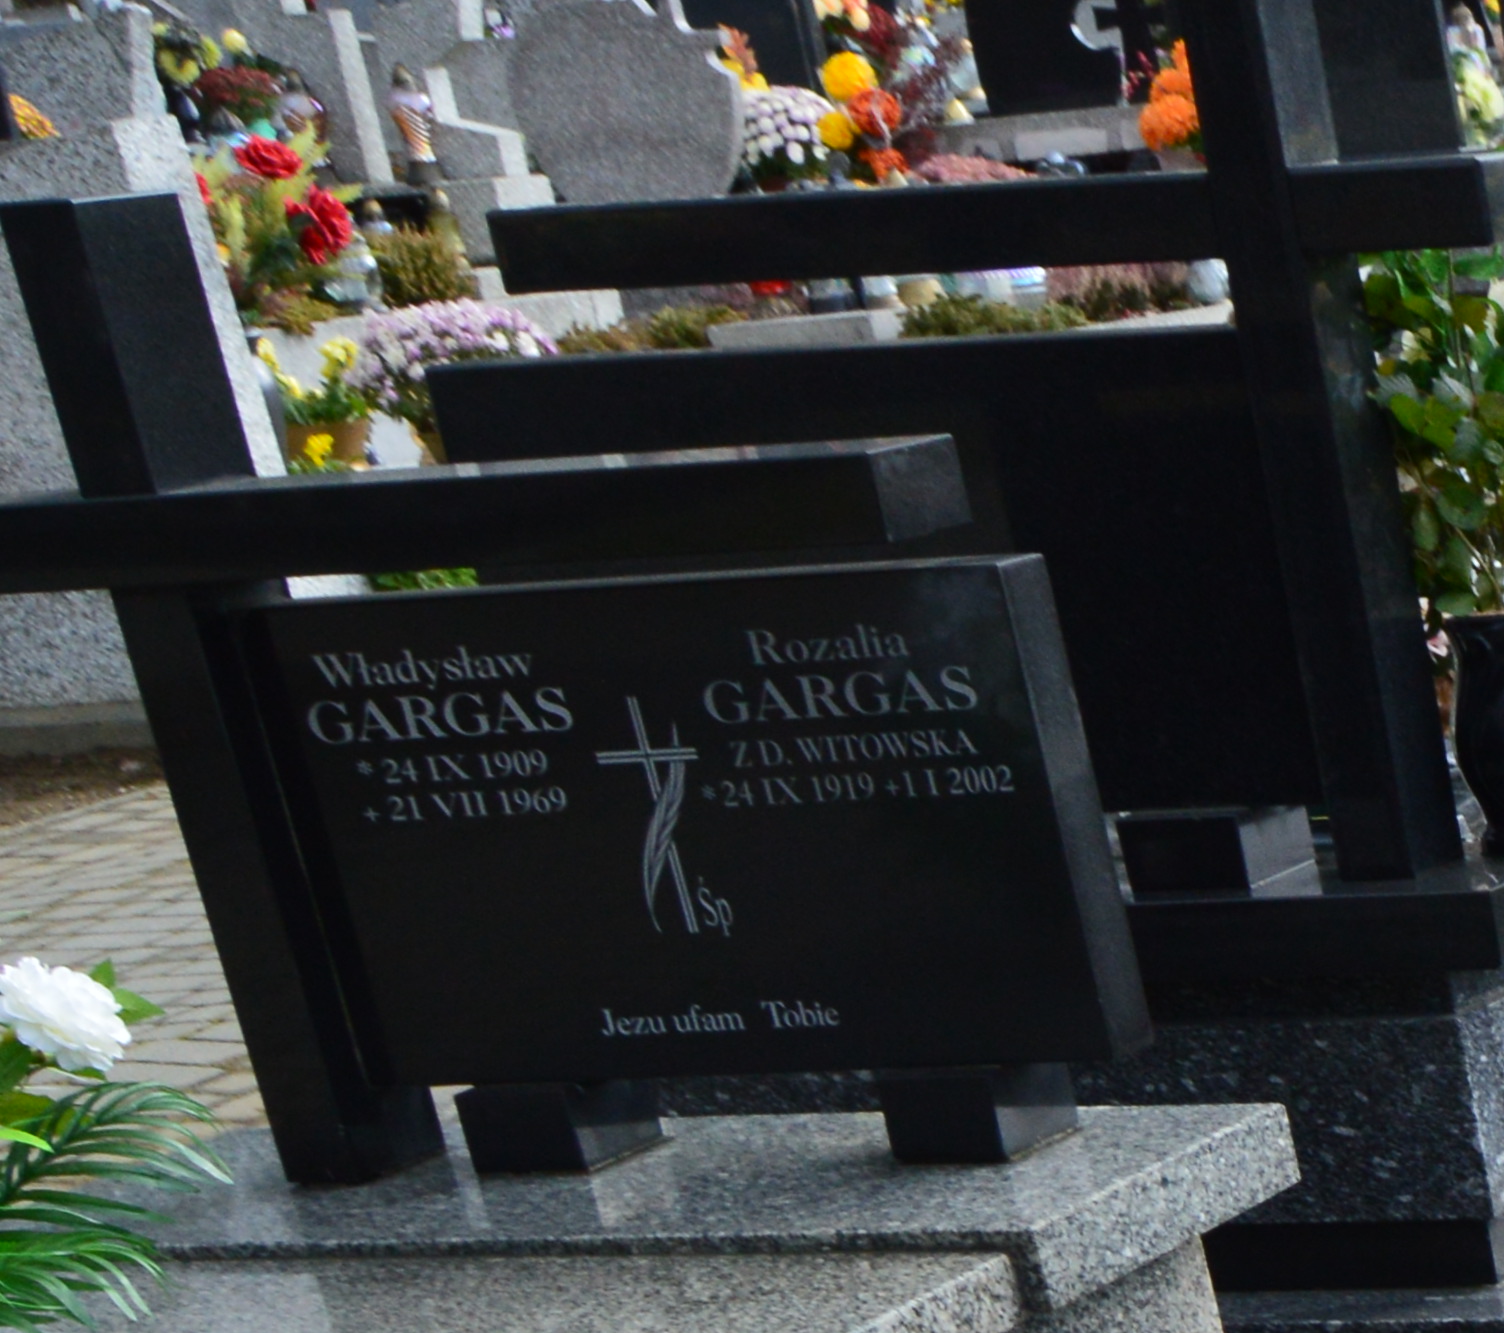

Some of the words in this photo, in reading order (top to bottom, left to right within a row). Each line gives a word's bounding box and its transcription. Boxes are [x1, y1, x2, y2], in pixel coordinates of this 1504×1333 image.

[745, 623, 910, 666] Rozalia
[310, 644, 532, 691] Władysław
[307, 686, 574, 745] GARGAS
[703, 665, 979, 725] GARGAS
[381, 757, 419, 784] 24
[426, 753, 472, 782] IX
[478, 749, 549, 779] 1909
[730, 741, 753, 769] Z
[758, 739, 793, 767] D.
[796, 728, 981, 764] WITOWSKA
[387, 795, 424, 822] 21
[430, 791, 488, 818] VII
[496, 786, 569, 816] 1969
[762, 777, 803, 805] IX
[810, 772, 876, 802] 1919
[948, 764, 1015, 795] 2002
[601, 1008, 668, 1037] Jezu
[673, 1004, 747, 1033] ufam
[760, 1000, 841, 1029] Tobie
